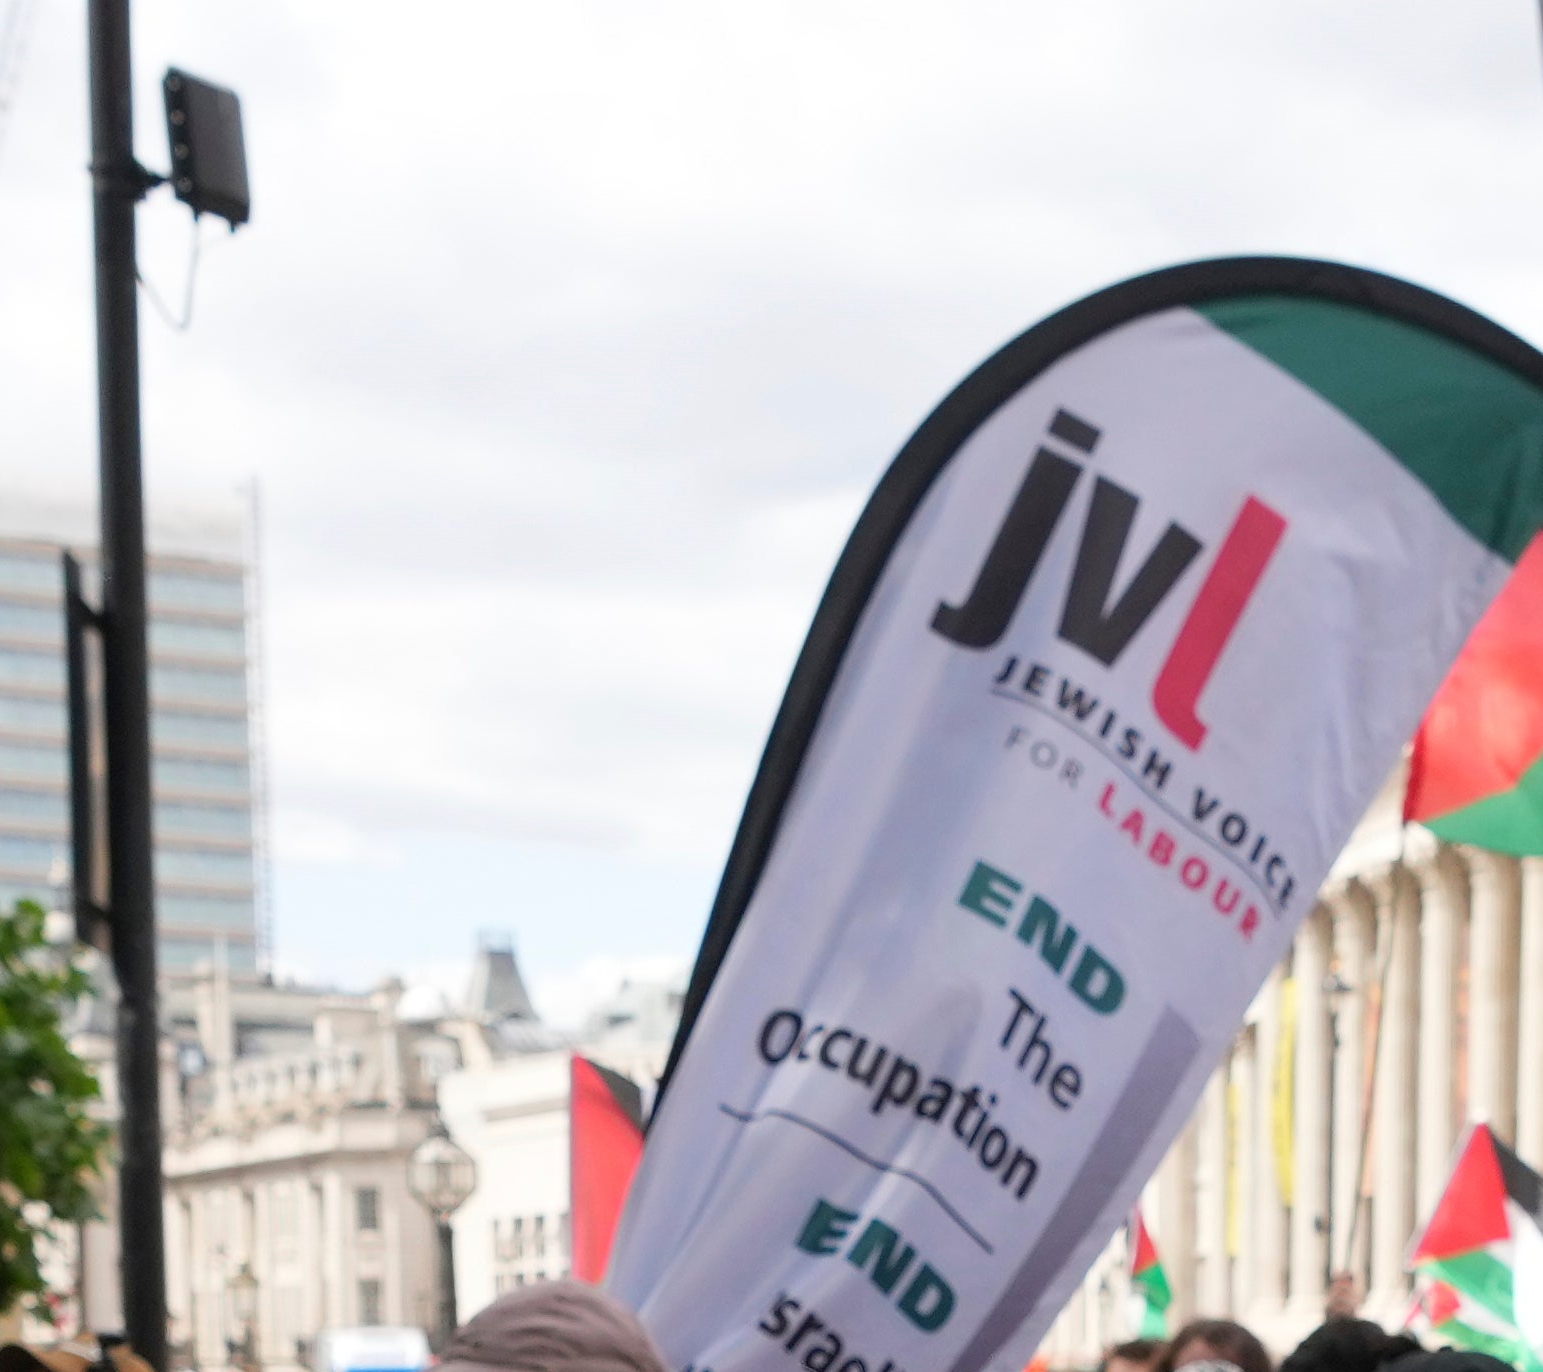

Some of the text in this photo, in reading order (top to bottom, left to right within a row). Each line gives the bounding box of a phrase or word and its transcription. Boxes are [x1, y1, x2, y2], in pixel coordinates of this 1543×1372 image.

[930, 407, 1289, 754] jvl
[994, 655, 1174, 790] JEWISH
[1004, 722, 1261, 942] FOR LABOUR
[959, 859, 1128, 1016] END
[757, 1008, 1041, 1202] Occupation
[1000, 987, 1083, 1110] The
[795, 1198, 959, 1336] END
